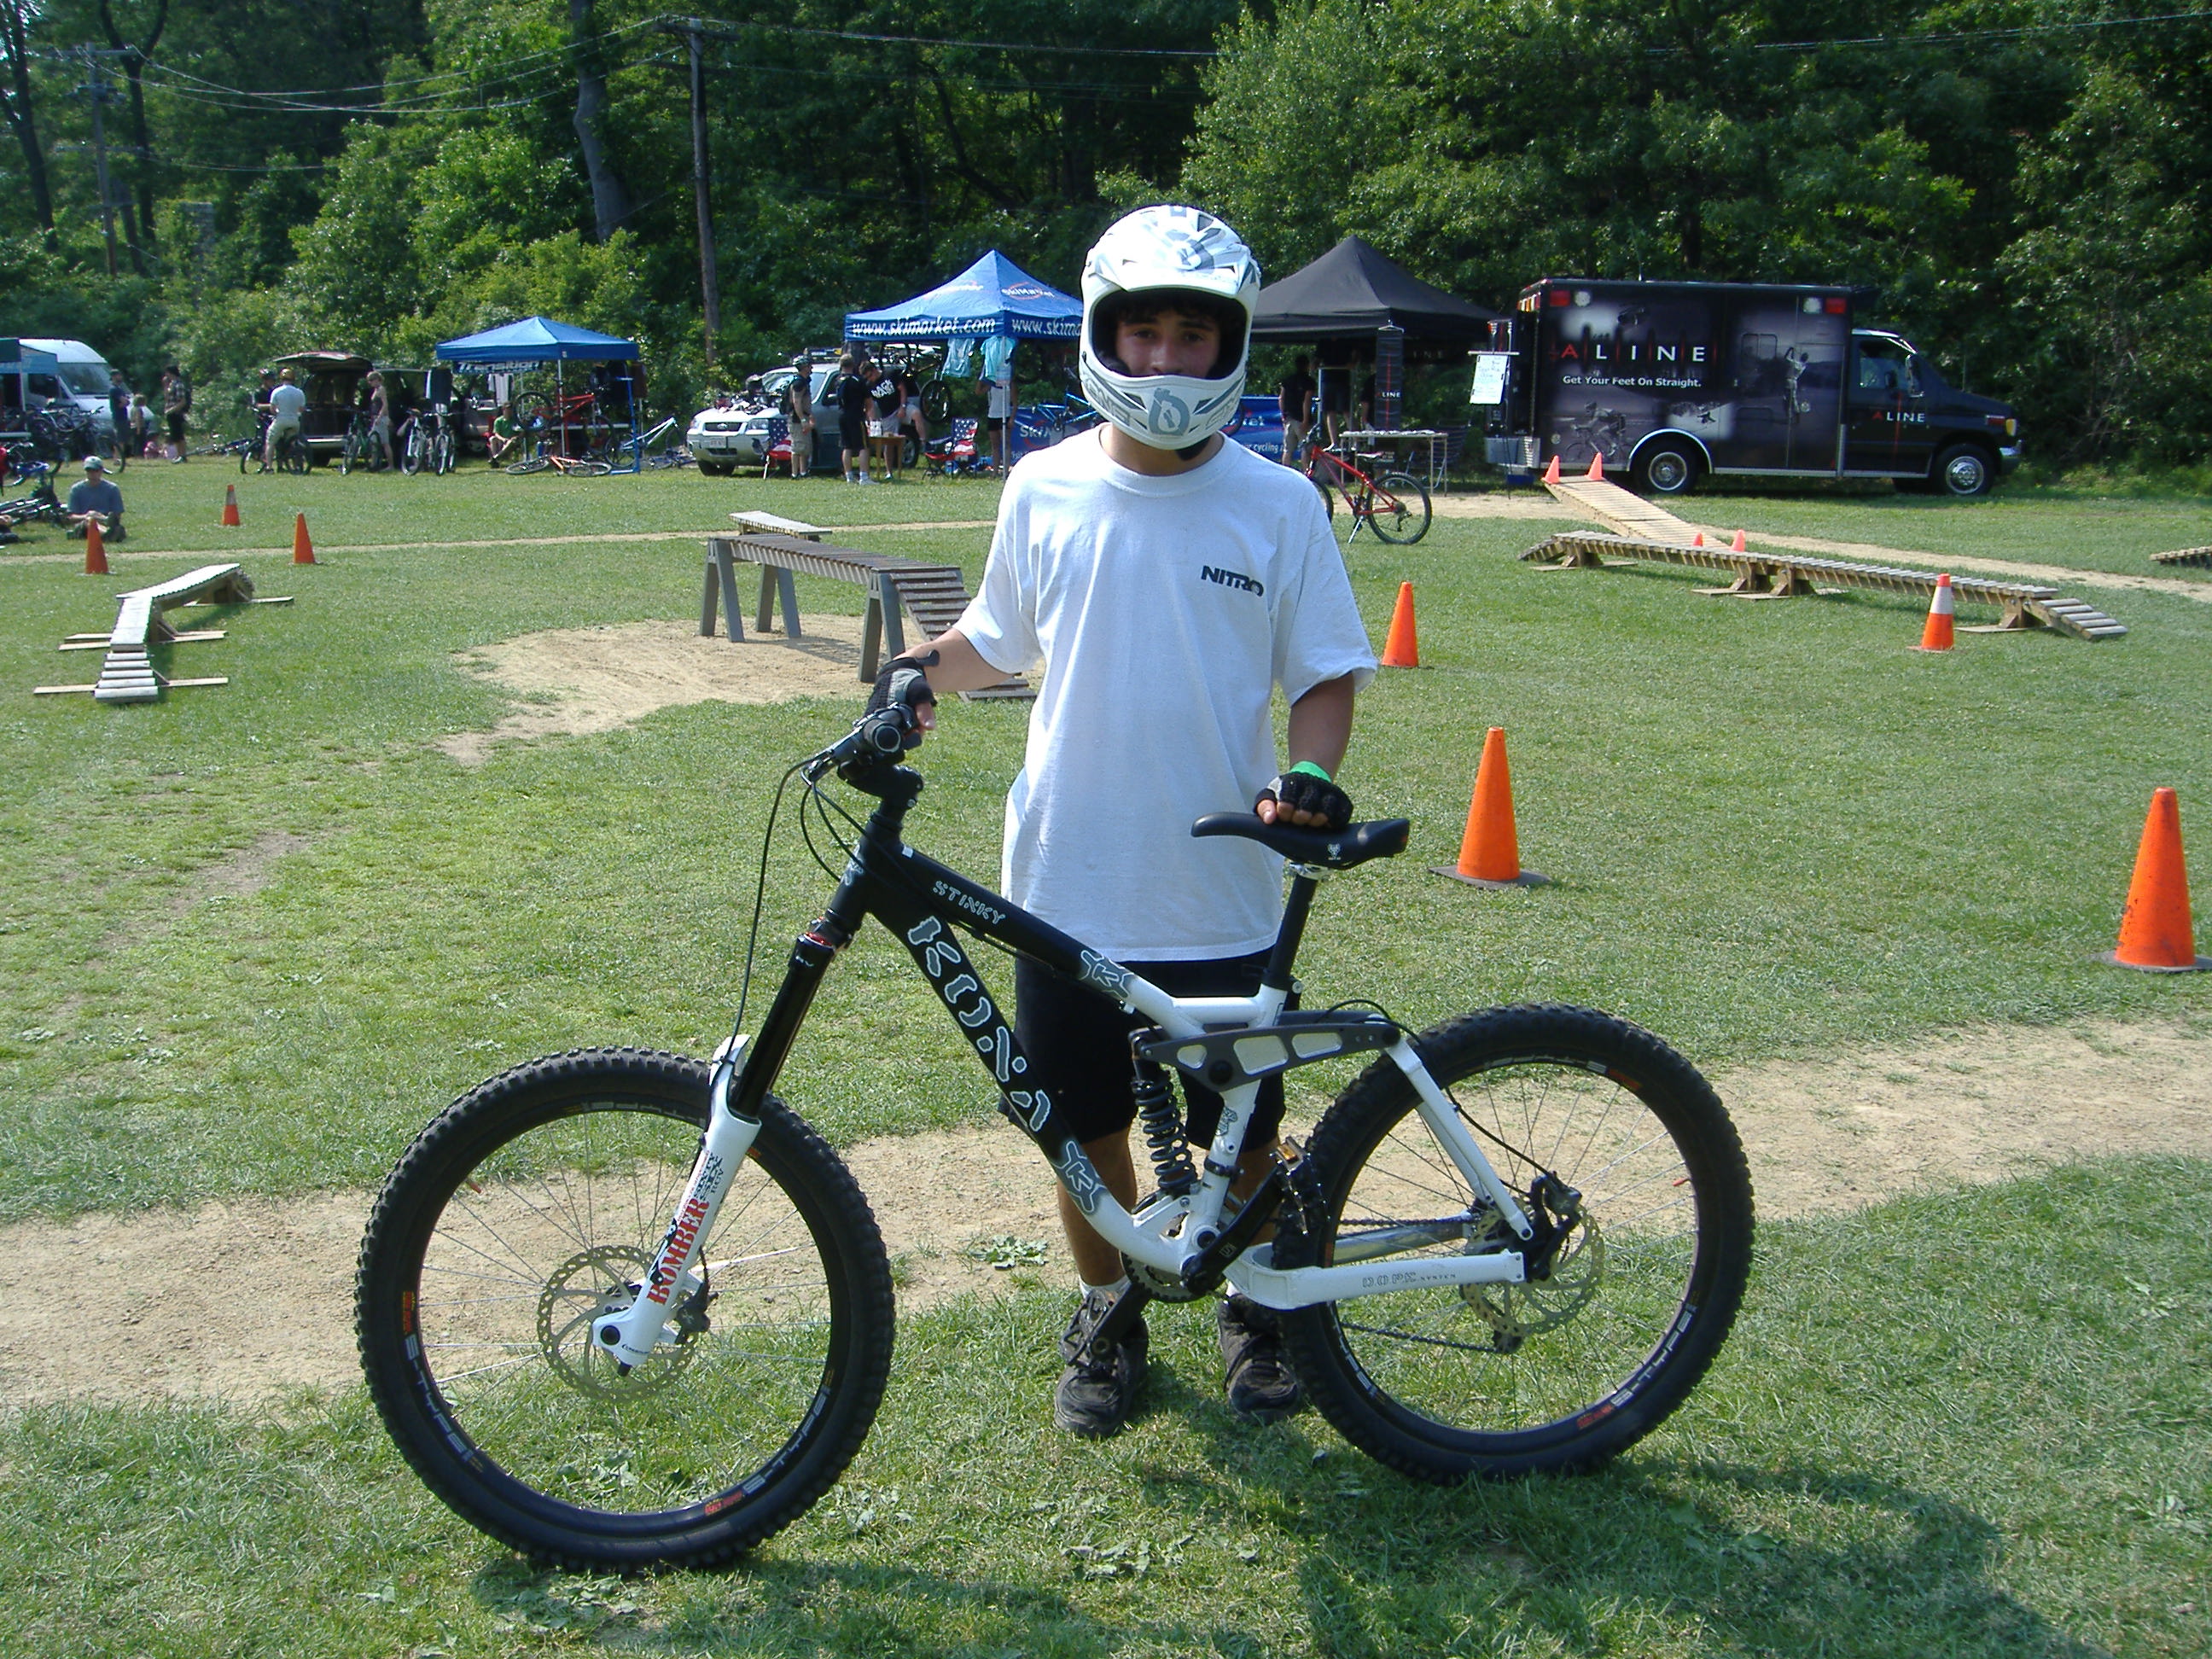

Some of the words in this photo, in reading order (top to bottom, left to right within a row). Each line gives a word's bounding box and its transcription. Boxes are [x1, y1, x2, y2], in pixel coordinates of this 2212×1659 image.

[852, 315, 996, 336] www.skimarket.com
[1011, 317, 1082, 336] www.skima
[1563, 375, 1581, 385] Get
[1585, 375, 1610, 386] Your
[1612, 376, 1635, 386] Feet
[1638, 377, 1654, 387] On
[1656, 377, 1702, 389] Straight.
[1871, 411, 1926, 422] ALINE
[1254, 442, 1278, 454] cycling
[1201, 565, 1265, 597] NITRO
[933, 881, 1006, 925] STINKY
[908, 915, 1051, 1132] KONA
[647, 1198, 710, 1306] BOMBER
